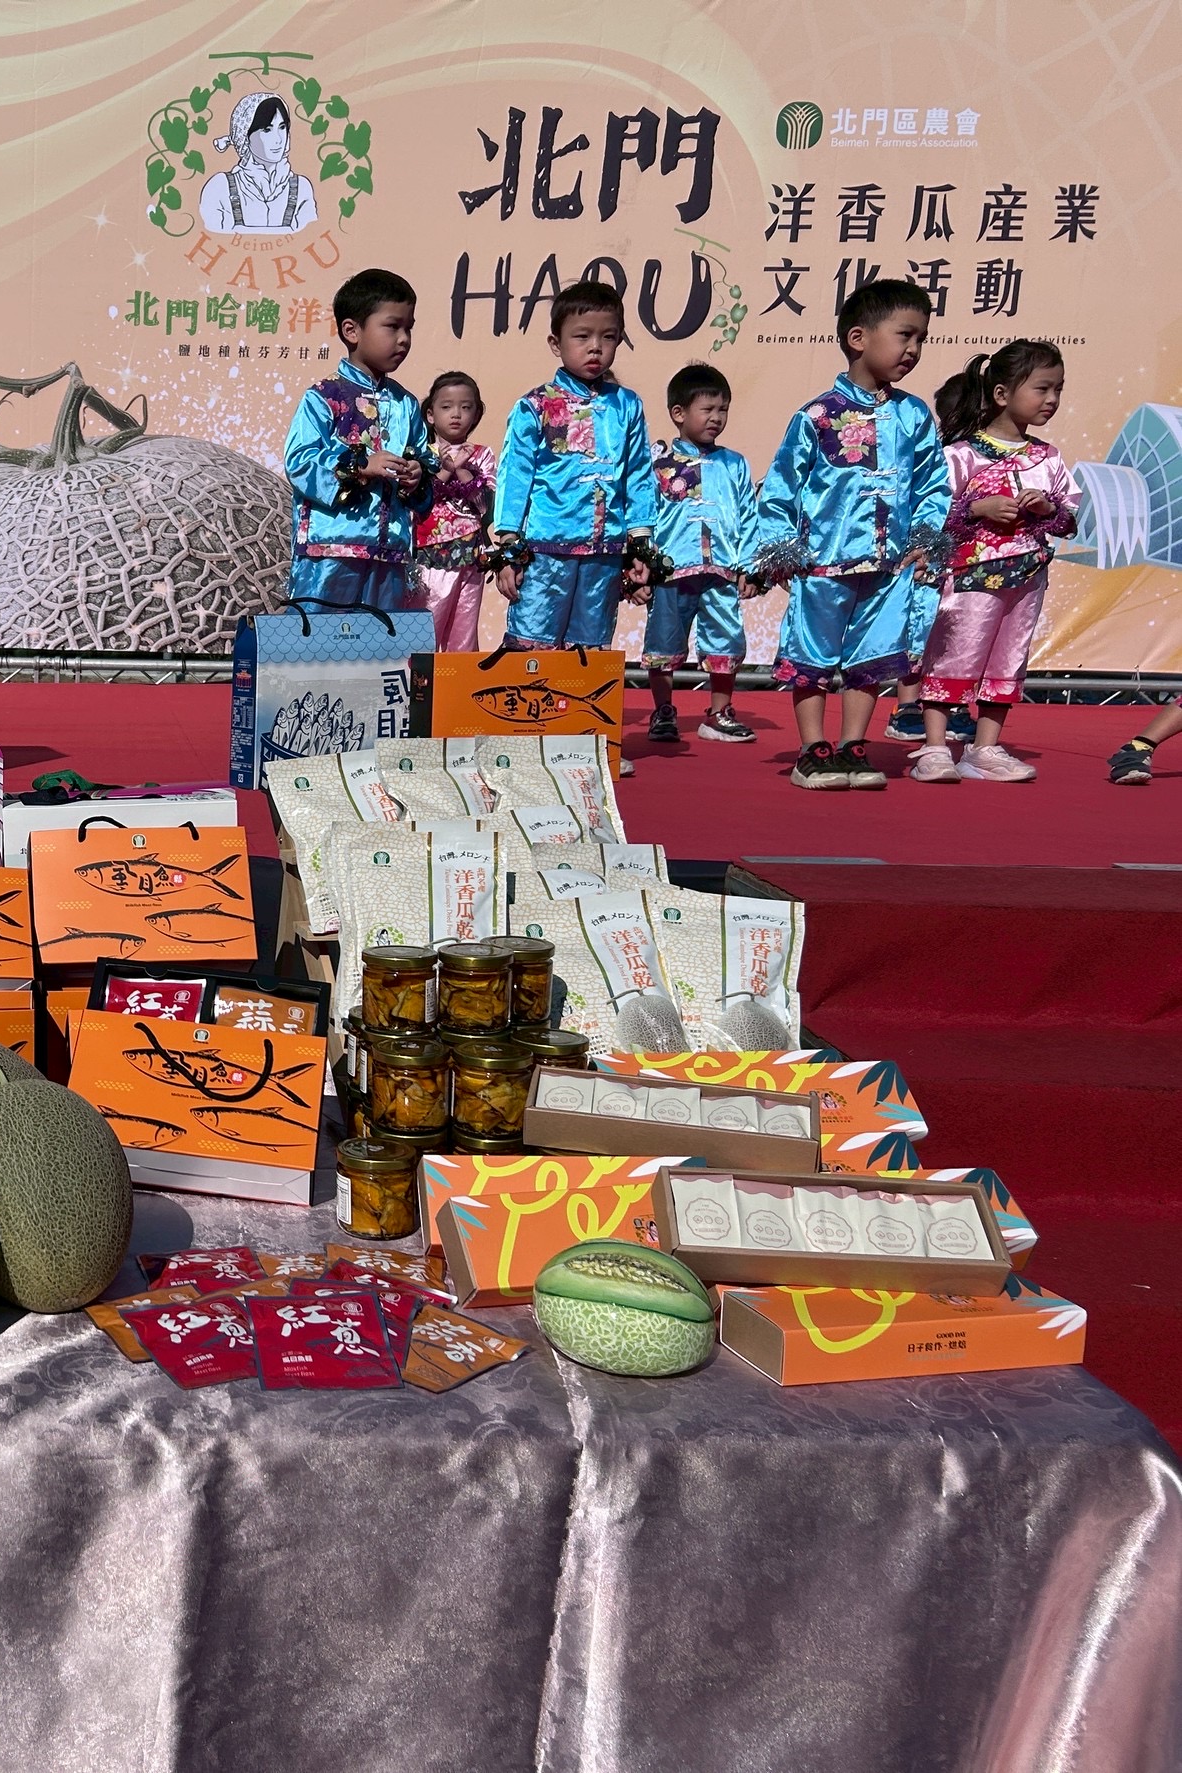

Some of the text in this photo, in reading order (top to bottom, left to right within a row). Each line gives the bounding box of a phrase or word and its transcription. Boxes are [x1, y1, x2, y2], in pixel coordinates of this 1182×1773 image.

[830, 107, 981, 135] 北門區農會
[831, 138, 868, 147] Beimen
[458, 105, 721, 224] 北門
[184, 230, 340, 290] HARU
[230, 232, 294, 251] Beimen
[178, 344, 330, 360] 鹽地種植芬芳甘甜
[757, 334, 804, 344] Beimen
[454, 869, 476, 941] 洋香瓜乾
[611, 929, 656, 989] 洋香瓜乾
[749, 927, 771, 998] 洋香瓜乾
